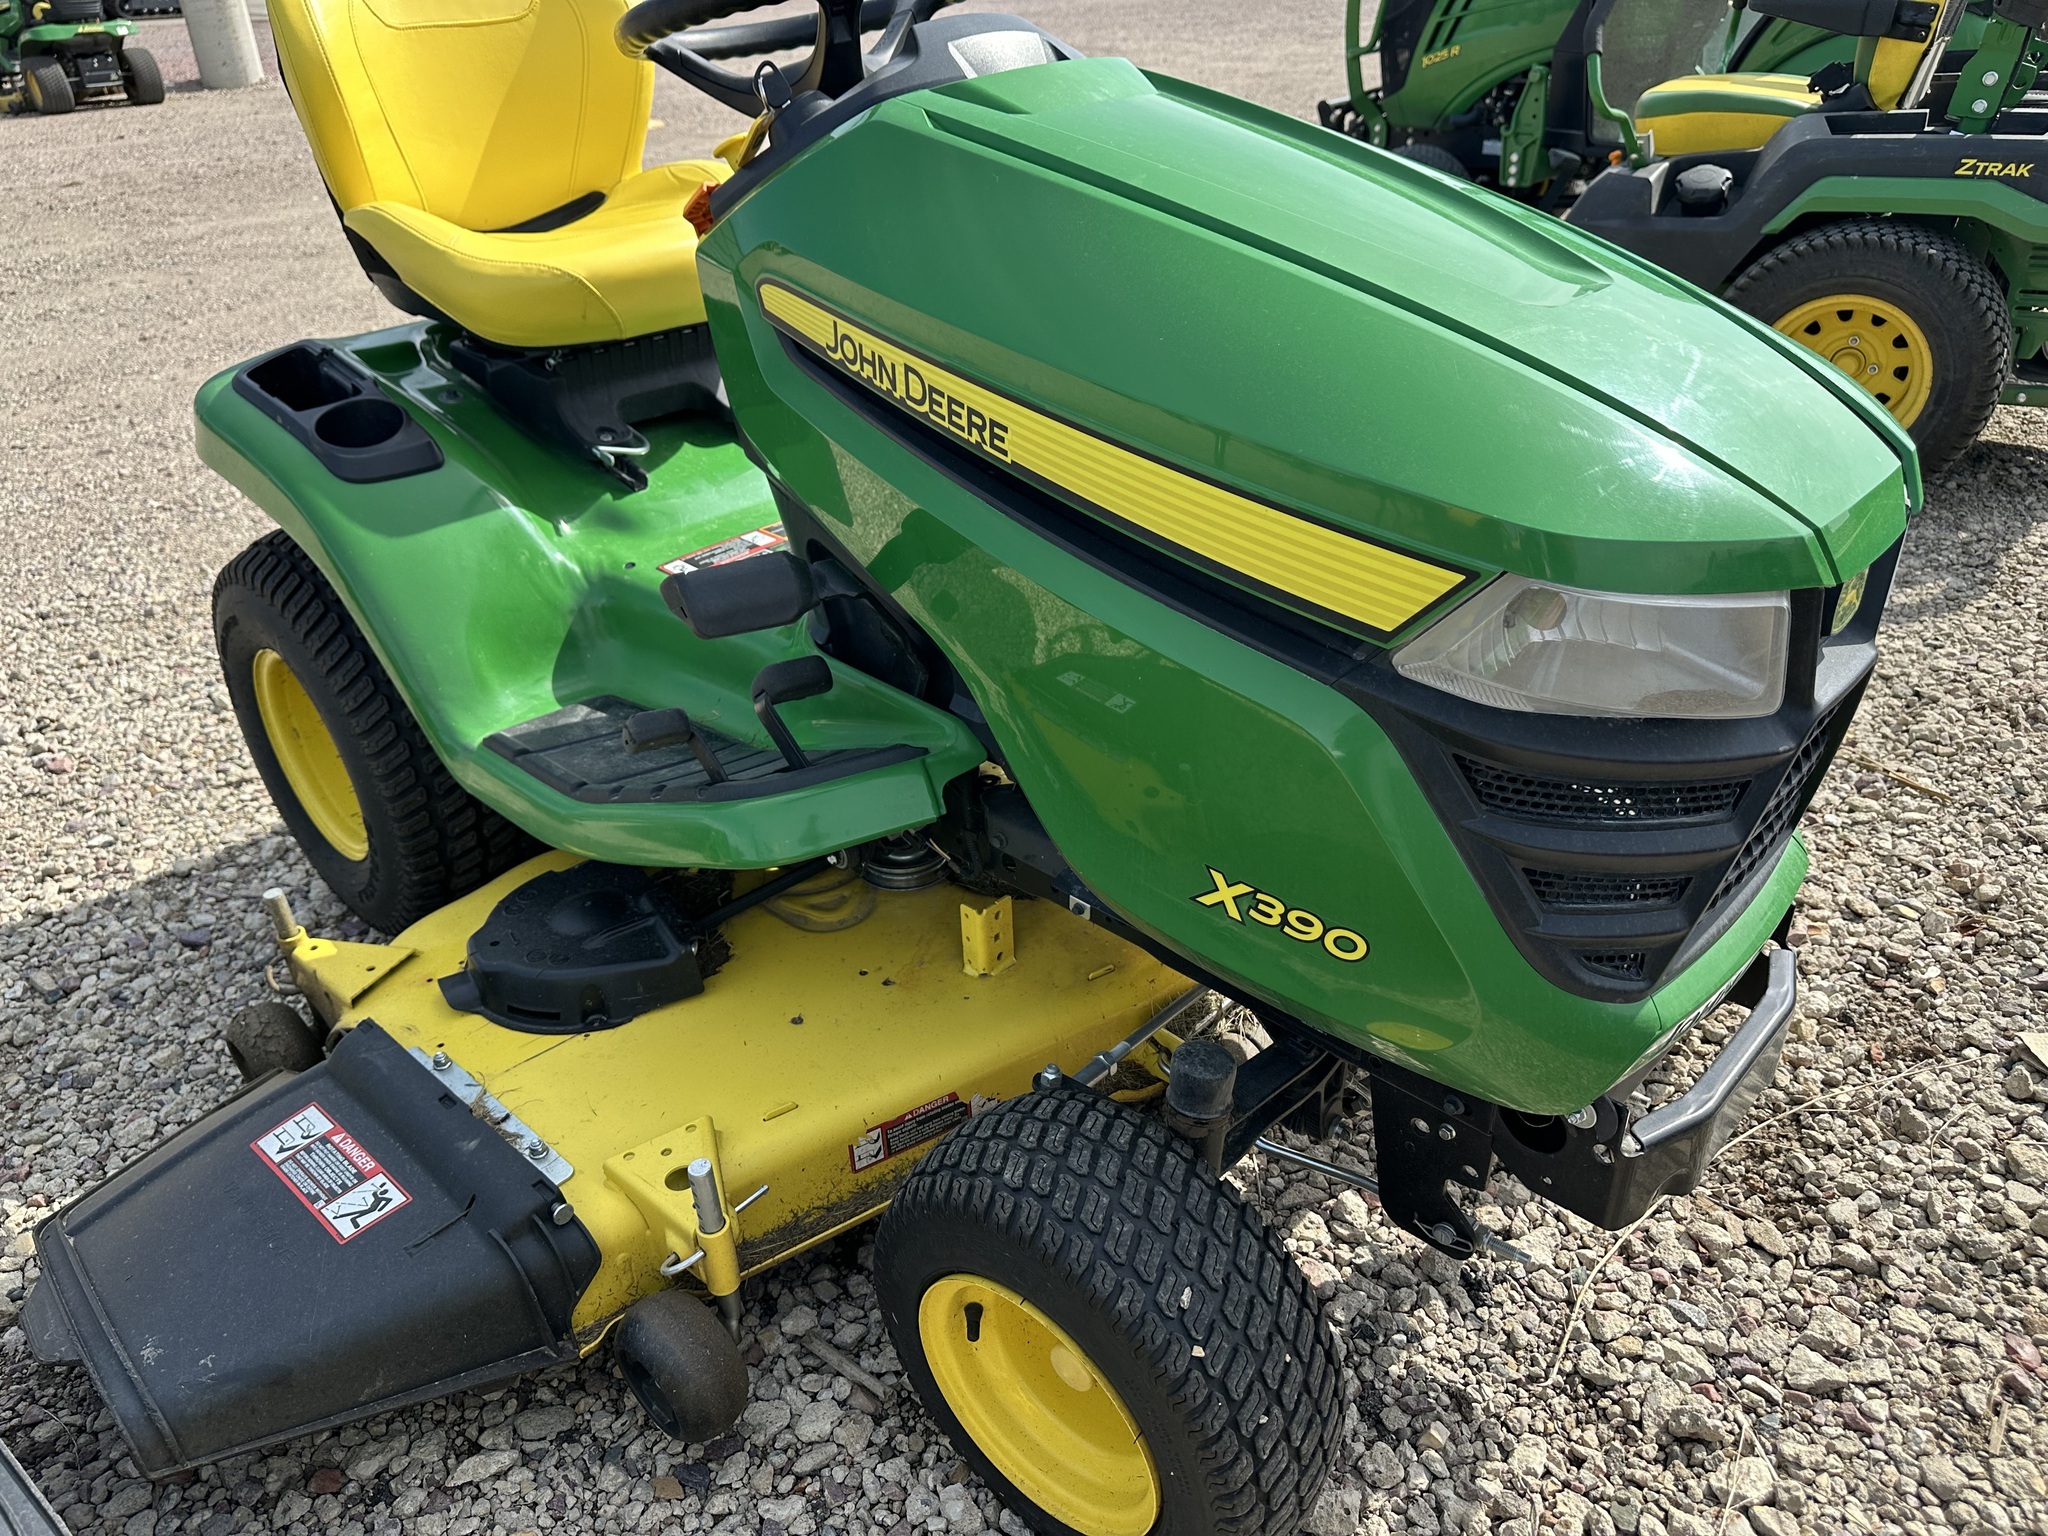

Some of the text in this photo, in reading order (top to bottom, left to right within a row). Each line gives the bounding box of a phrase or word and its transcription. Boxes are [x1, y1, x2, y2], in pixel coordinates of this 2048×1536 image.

[825, 319, 1009, 458] JOHN DEERE
[1190, 864, 1370, 963] X390
[913, 1095, 949, 1117] DANGER
[339, 1137, 376, 1173] DANGER
